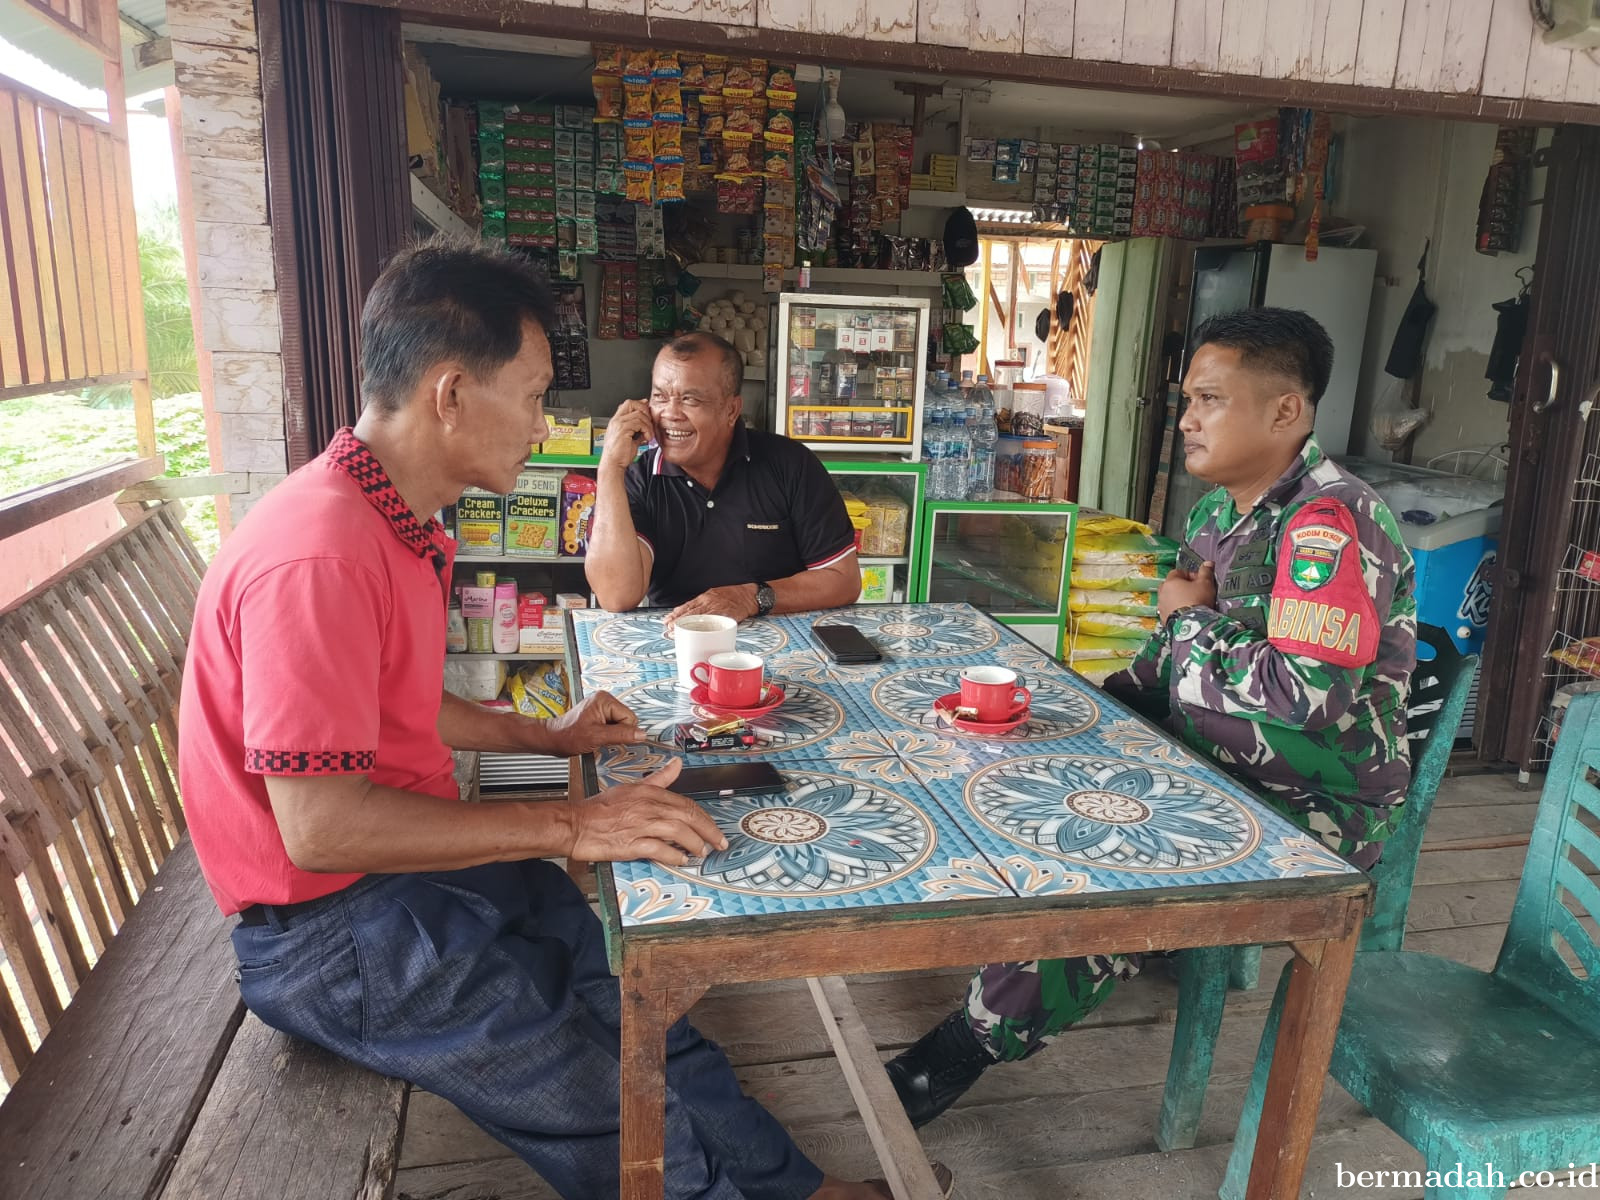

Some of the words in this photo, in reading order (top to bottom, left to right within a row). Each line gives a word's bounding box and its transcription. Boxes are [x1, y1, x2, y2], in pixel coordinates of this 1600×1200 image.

[517, 479, 529, 489] UP
[532, 480, 555, 490] SENG
[464, 497, 495, 508] Cream
[517, 495, 549, 507] Deluxe
[458, 508, 502, 519] Crackers
[510, 505, 555, 517] Crackers
[1296, 529, 1321, 539] KODIM
[1225, 575, 1240, 591] TNI
[1247, 572, 1273, 588] AD
[1267, 597, 1361, 656] ABINSA
